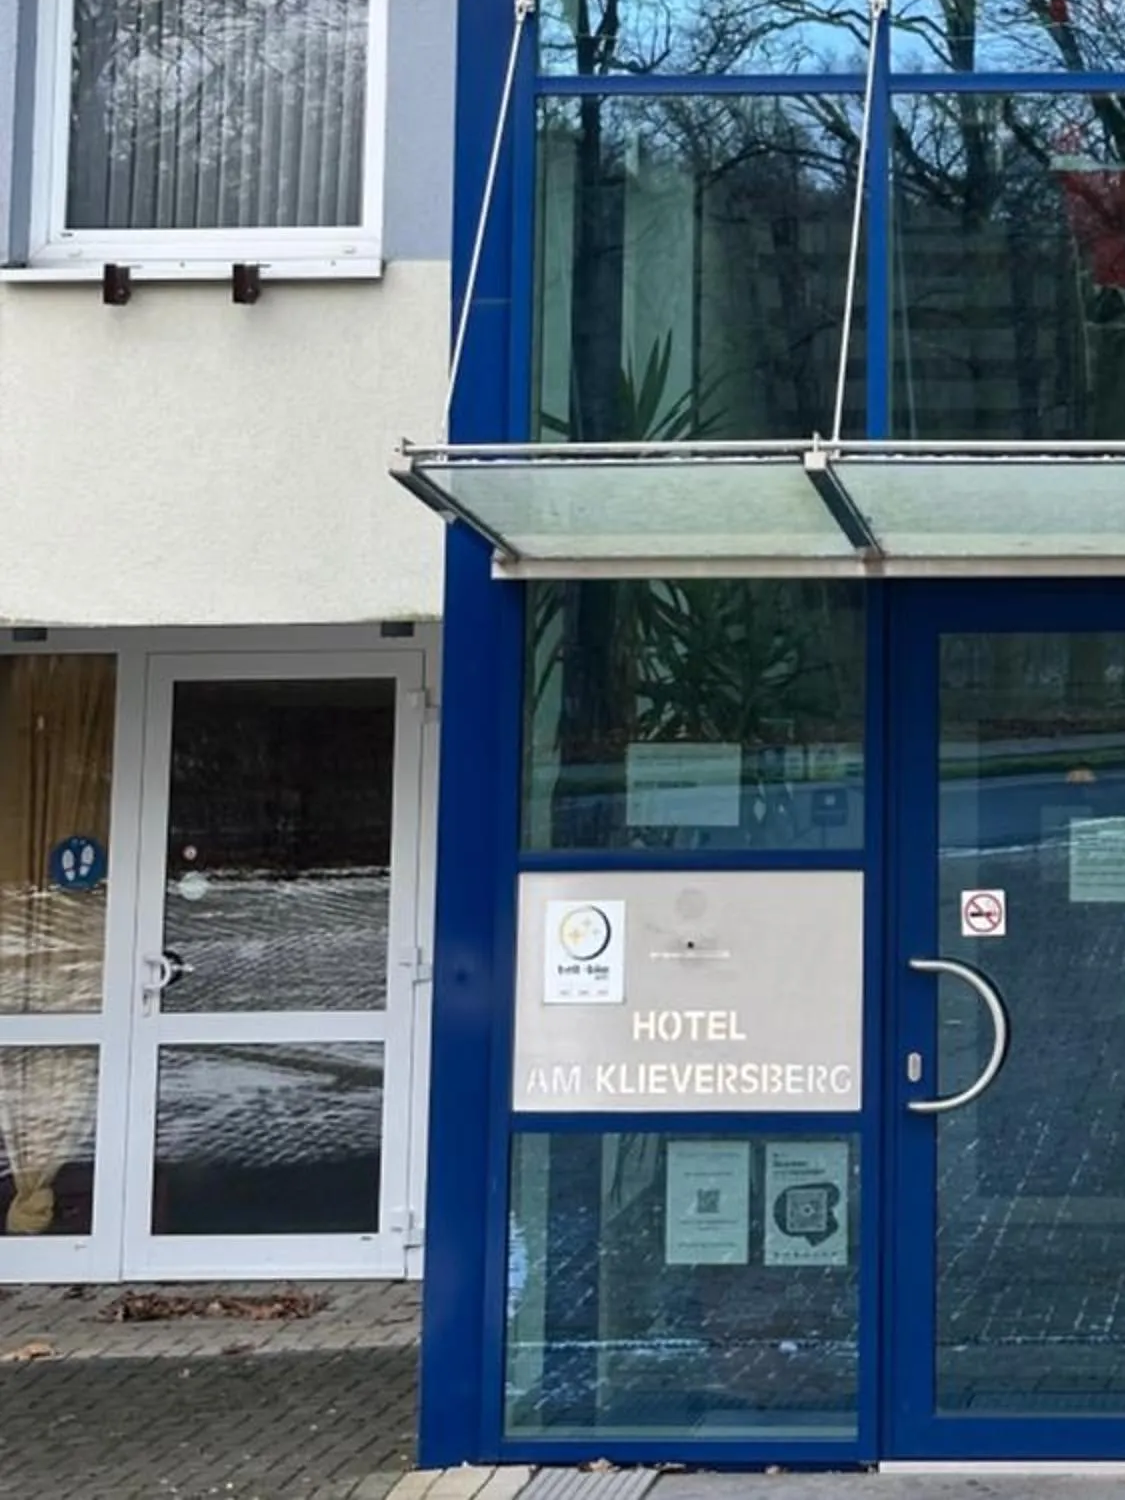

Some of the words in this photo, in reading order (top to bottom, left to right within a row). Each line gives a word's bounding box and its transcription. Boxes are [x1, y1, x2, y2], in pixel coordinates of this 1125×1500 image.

[632, 1010, 748, 1041] HOTEL
[526, 1064, 581, 1094] AM
[596, 1063, 852, 1094] KLIEVERSBERG
